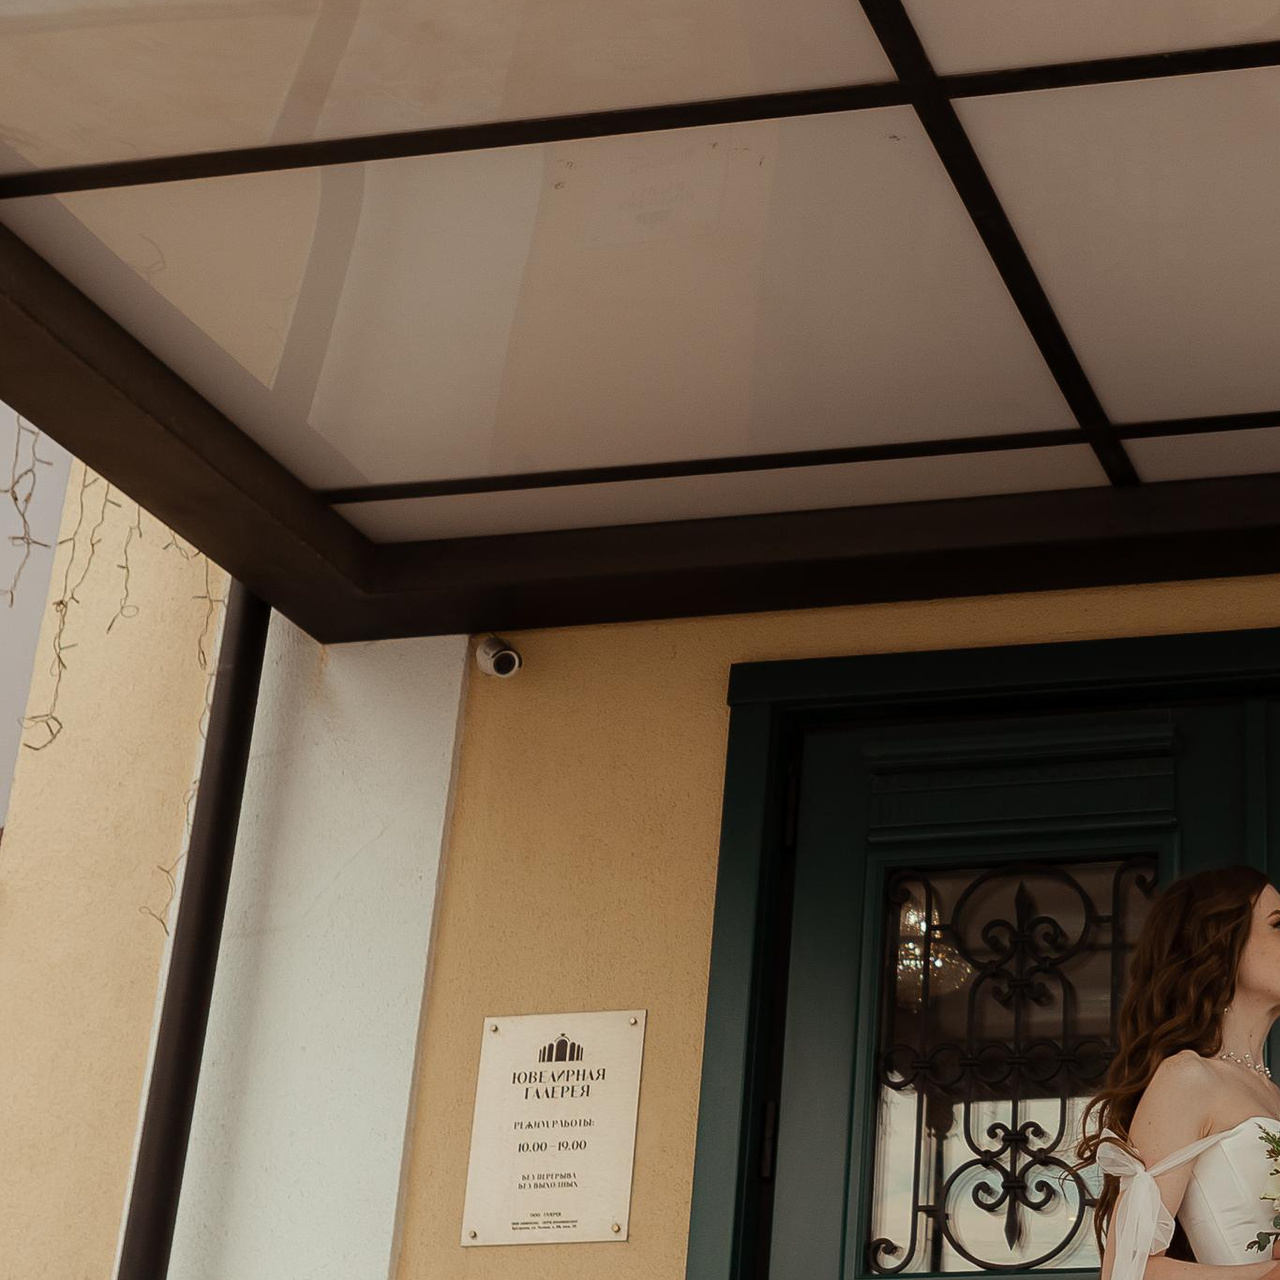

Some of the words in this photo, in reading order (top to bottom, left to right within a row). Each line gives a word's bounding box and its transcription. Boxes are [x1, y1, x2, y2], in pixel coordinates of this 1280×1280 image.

[512, 1068, 605, 1084] ЮВЕЛИРНАЯ
[525, 1084, 590, 1100] ГАЛЕРЕЯ
[518, 1141, 548, 1152] 10.00
[558, 1140, 587, 1151] 19.00
